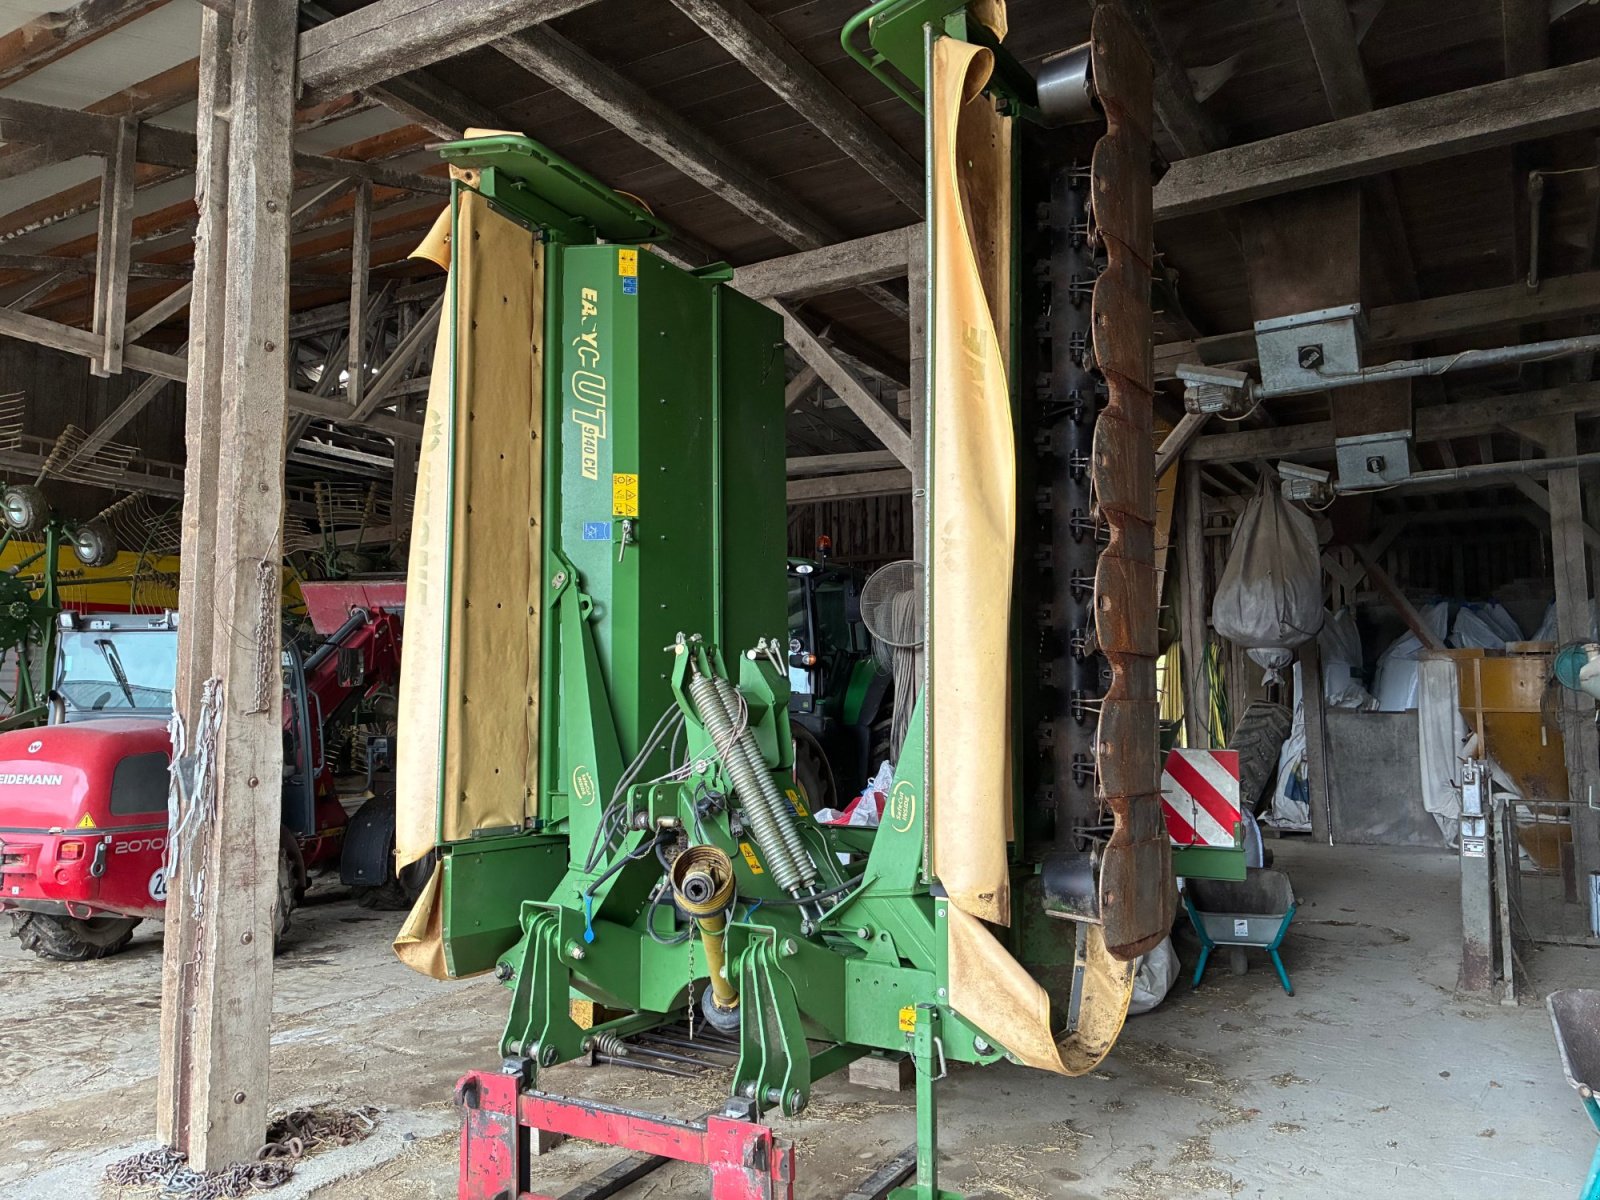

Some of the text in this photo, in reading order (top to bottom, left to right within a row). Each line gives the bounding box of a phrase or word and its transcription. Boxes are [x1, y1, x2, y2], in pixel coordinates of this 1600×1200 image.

[572, 287, 606, 476] EAYCUT 9140 CV
